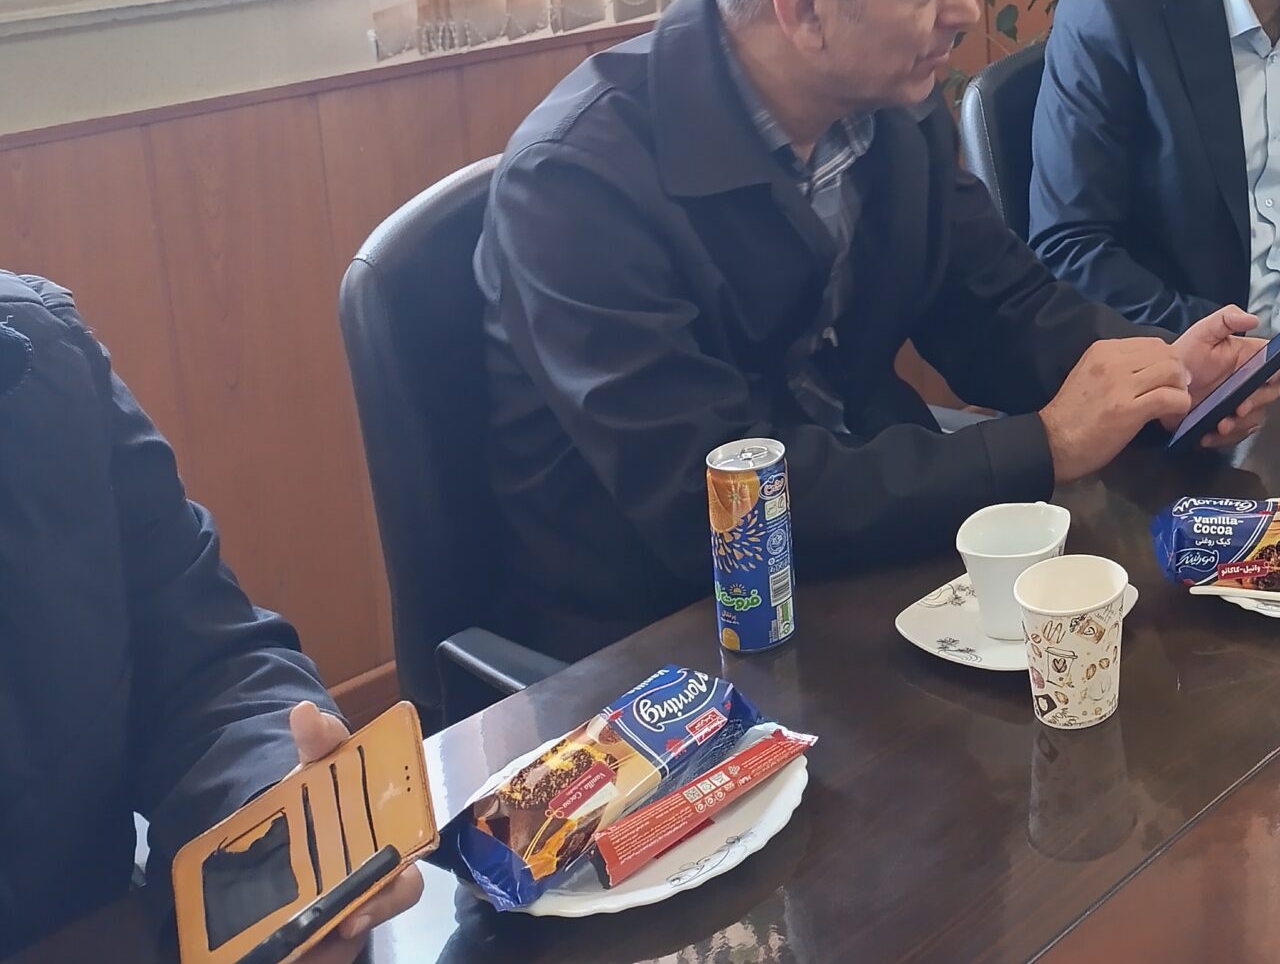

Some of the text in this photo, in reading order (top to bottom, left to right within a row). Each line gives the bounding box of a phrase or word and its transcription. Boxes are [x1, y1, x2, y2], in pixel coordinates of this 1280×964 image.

[1173, 498, 1254, 512] Morning
[1193, 523, 1233, 536] Cocoa
[1195, 536, 1231, 547] کیک روغنی
[640, 670, 709, 724] Morning
